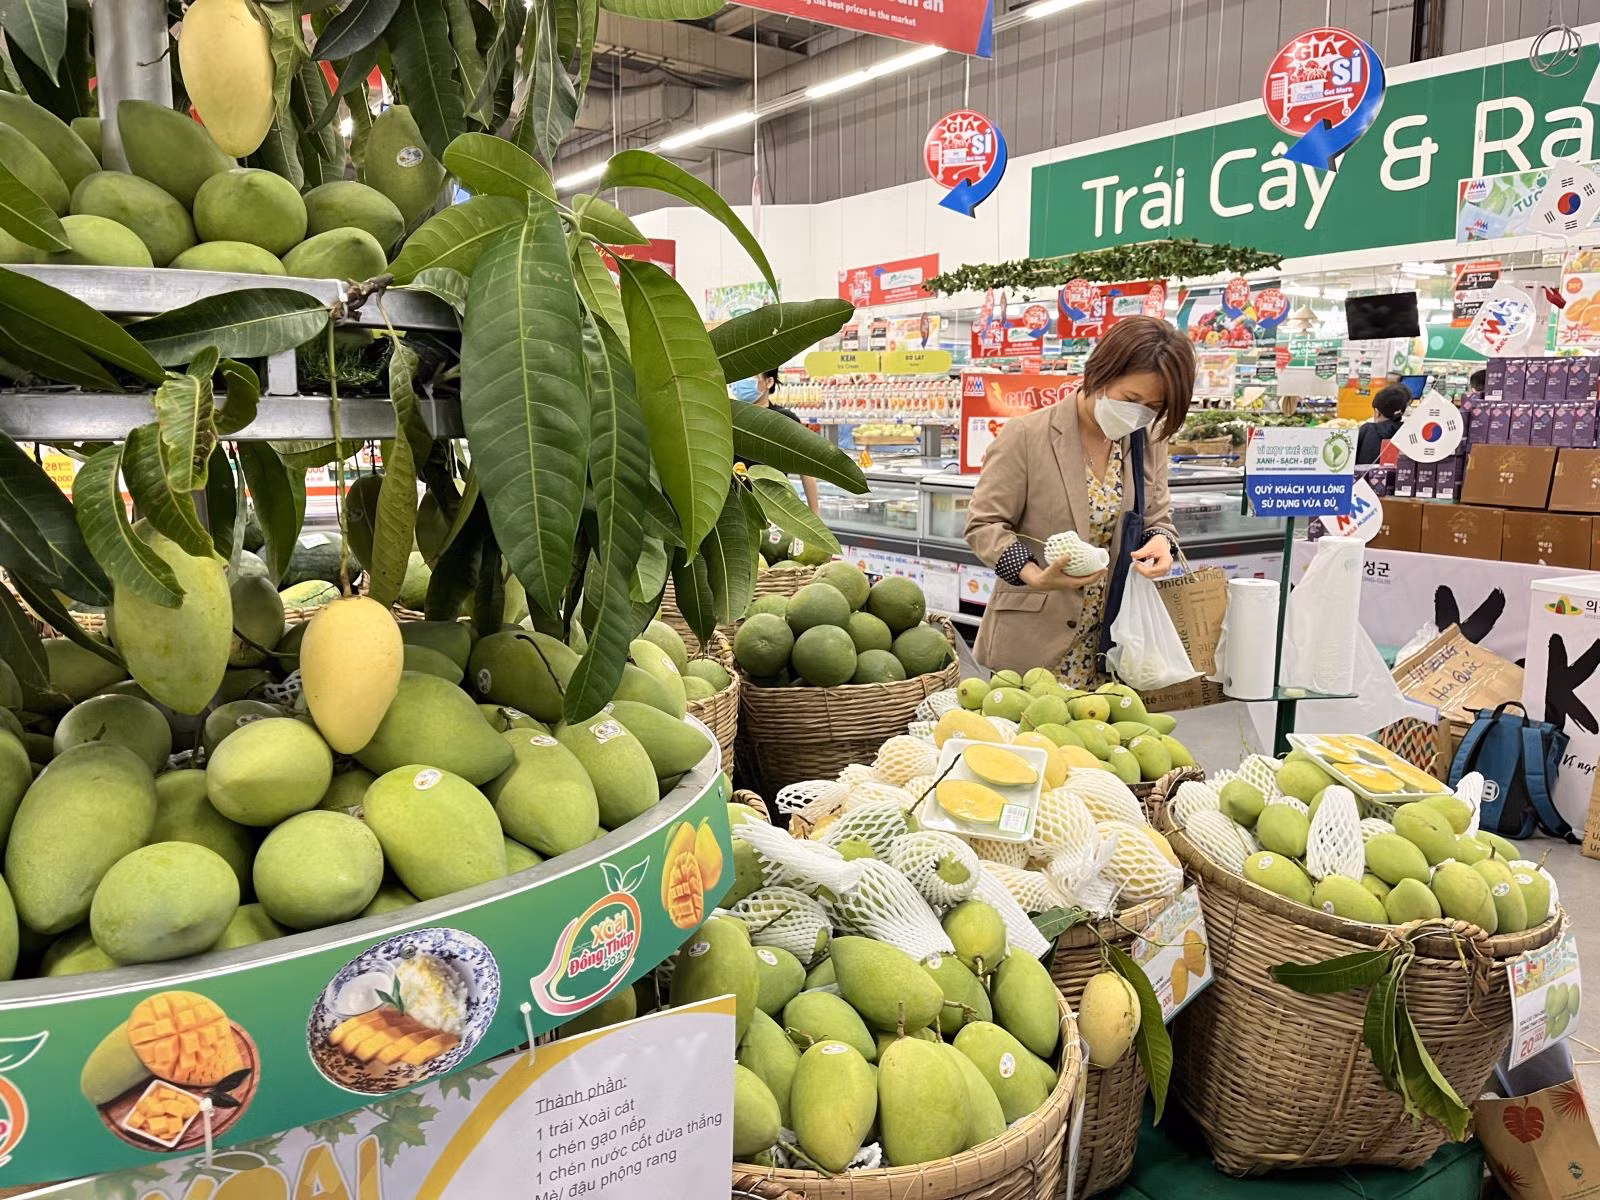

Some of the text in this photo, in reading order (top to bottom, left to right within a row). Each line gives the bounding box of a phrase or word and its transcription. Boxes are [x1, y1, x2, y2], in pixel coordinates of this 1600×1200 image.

[845, 5, 868, 15] prices
[869, 8, 876, 17] in
[878, 10, 890, 20] the
[891, 13, 917, 26] market
[1082, 164, 1185, 238] Trái
[1210, 140, 1344, 230] Cây
[1379, 114, 1440, 191] &
[840, 354, 856, 362] KEM
[1256, 457, 1275, 465] XANH
[1275, 484, 1304, 494] KHÁCH
[1307, 485, 1321, 493] VUI
[1276, 499, 1300, 510] DỤNG
[604, 930, 635, 957] Tháp
[536, 1077, 627, 1115] Thành phần:
[537, 1098, 635, 1140] 1 trái Xoài cát
[536, 1115, 646, 1162] 1 chén gạo nếp
[536, 1113, 722, 1185] 1 chén nước cốt dừa thắng
[569, 1180, 596, 1197] đậu
[600, 1161, 642, 1189] phộng
[647, 1150, 677, 1167] rang
